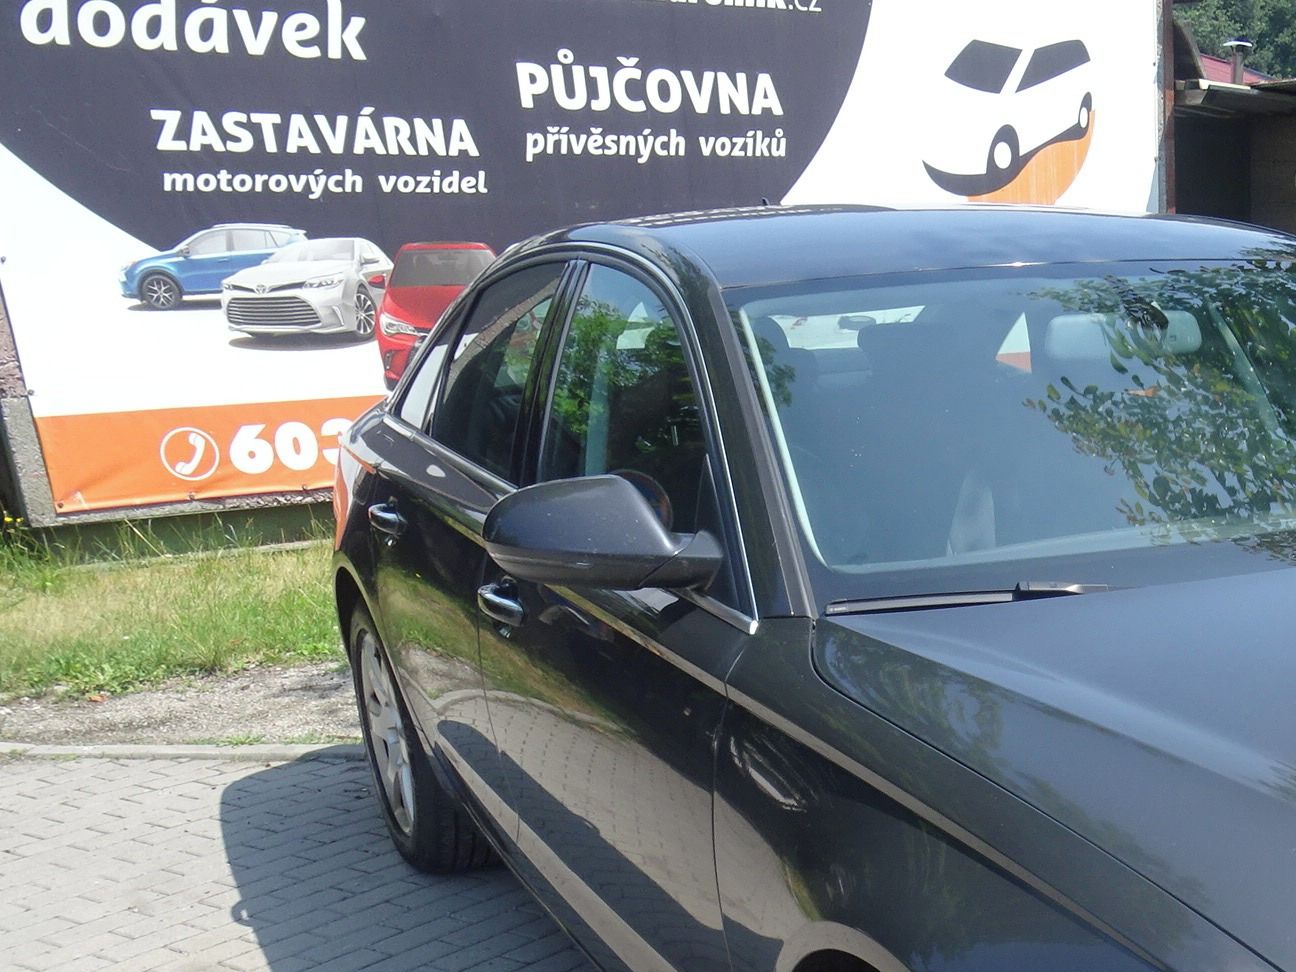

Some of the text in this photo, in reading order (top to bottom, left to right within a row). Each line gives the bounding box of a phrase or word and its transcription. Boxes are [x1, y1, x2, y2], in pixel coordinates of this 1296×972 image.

[20, 0, 368, 61] dodávek
[515, 48, 785, 116] PŮJČOVNA
[149, 106, 481, 157] ZASTAVÁRNA
[525, 126, 787, 164] přívěsných vozíků
[162, 168, 489, 200] motorových vozidel
